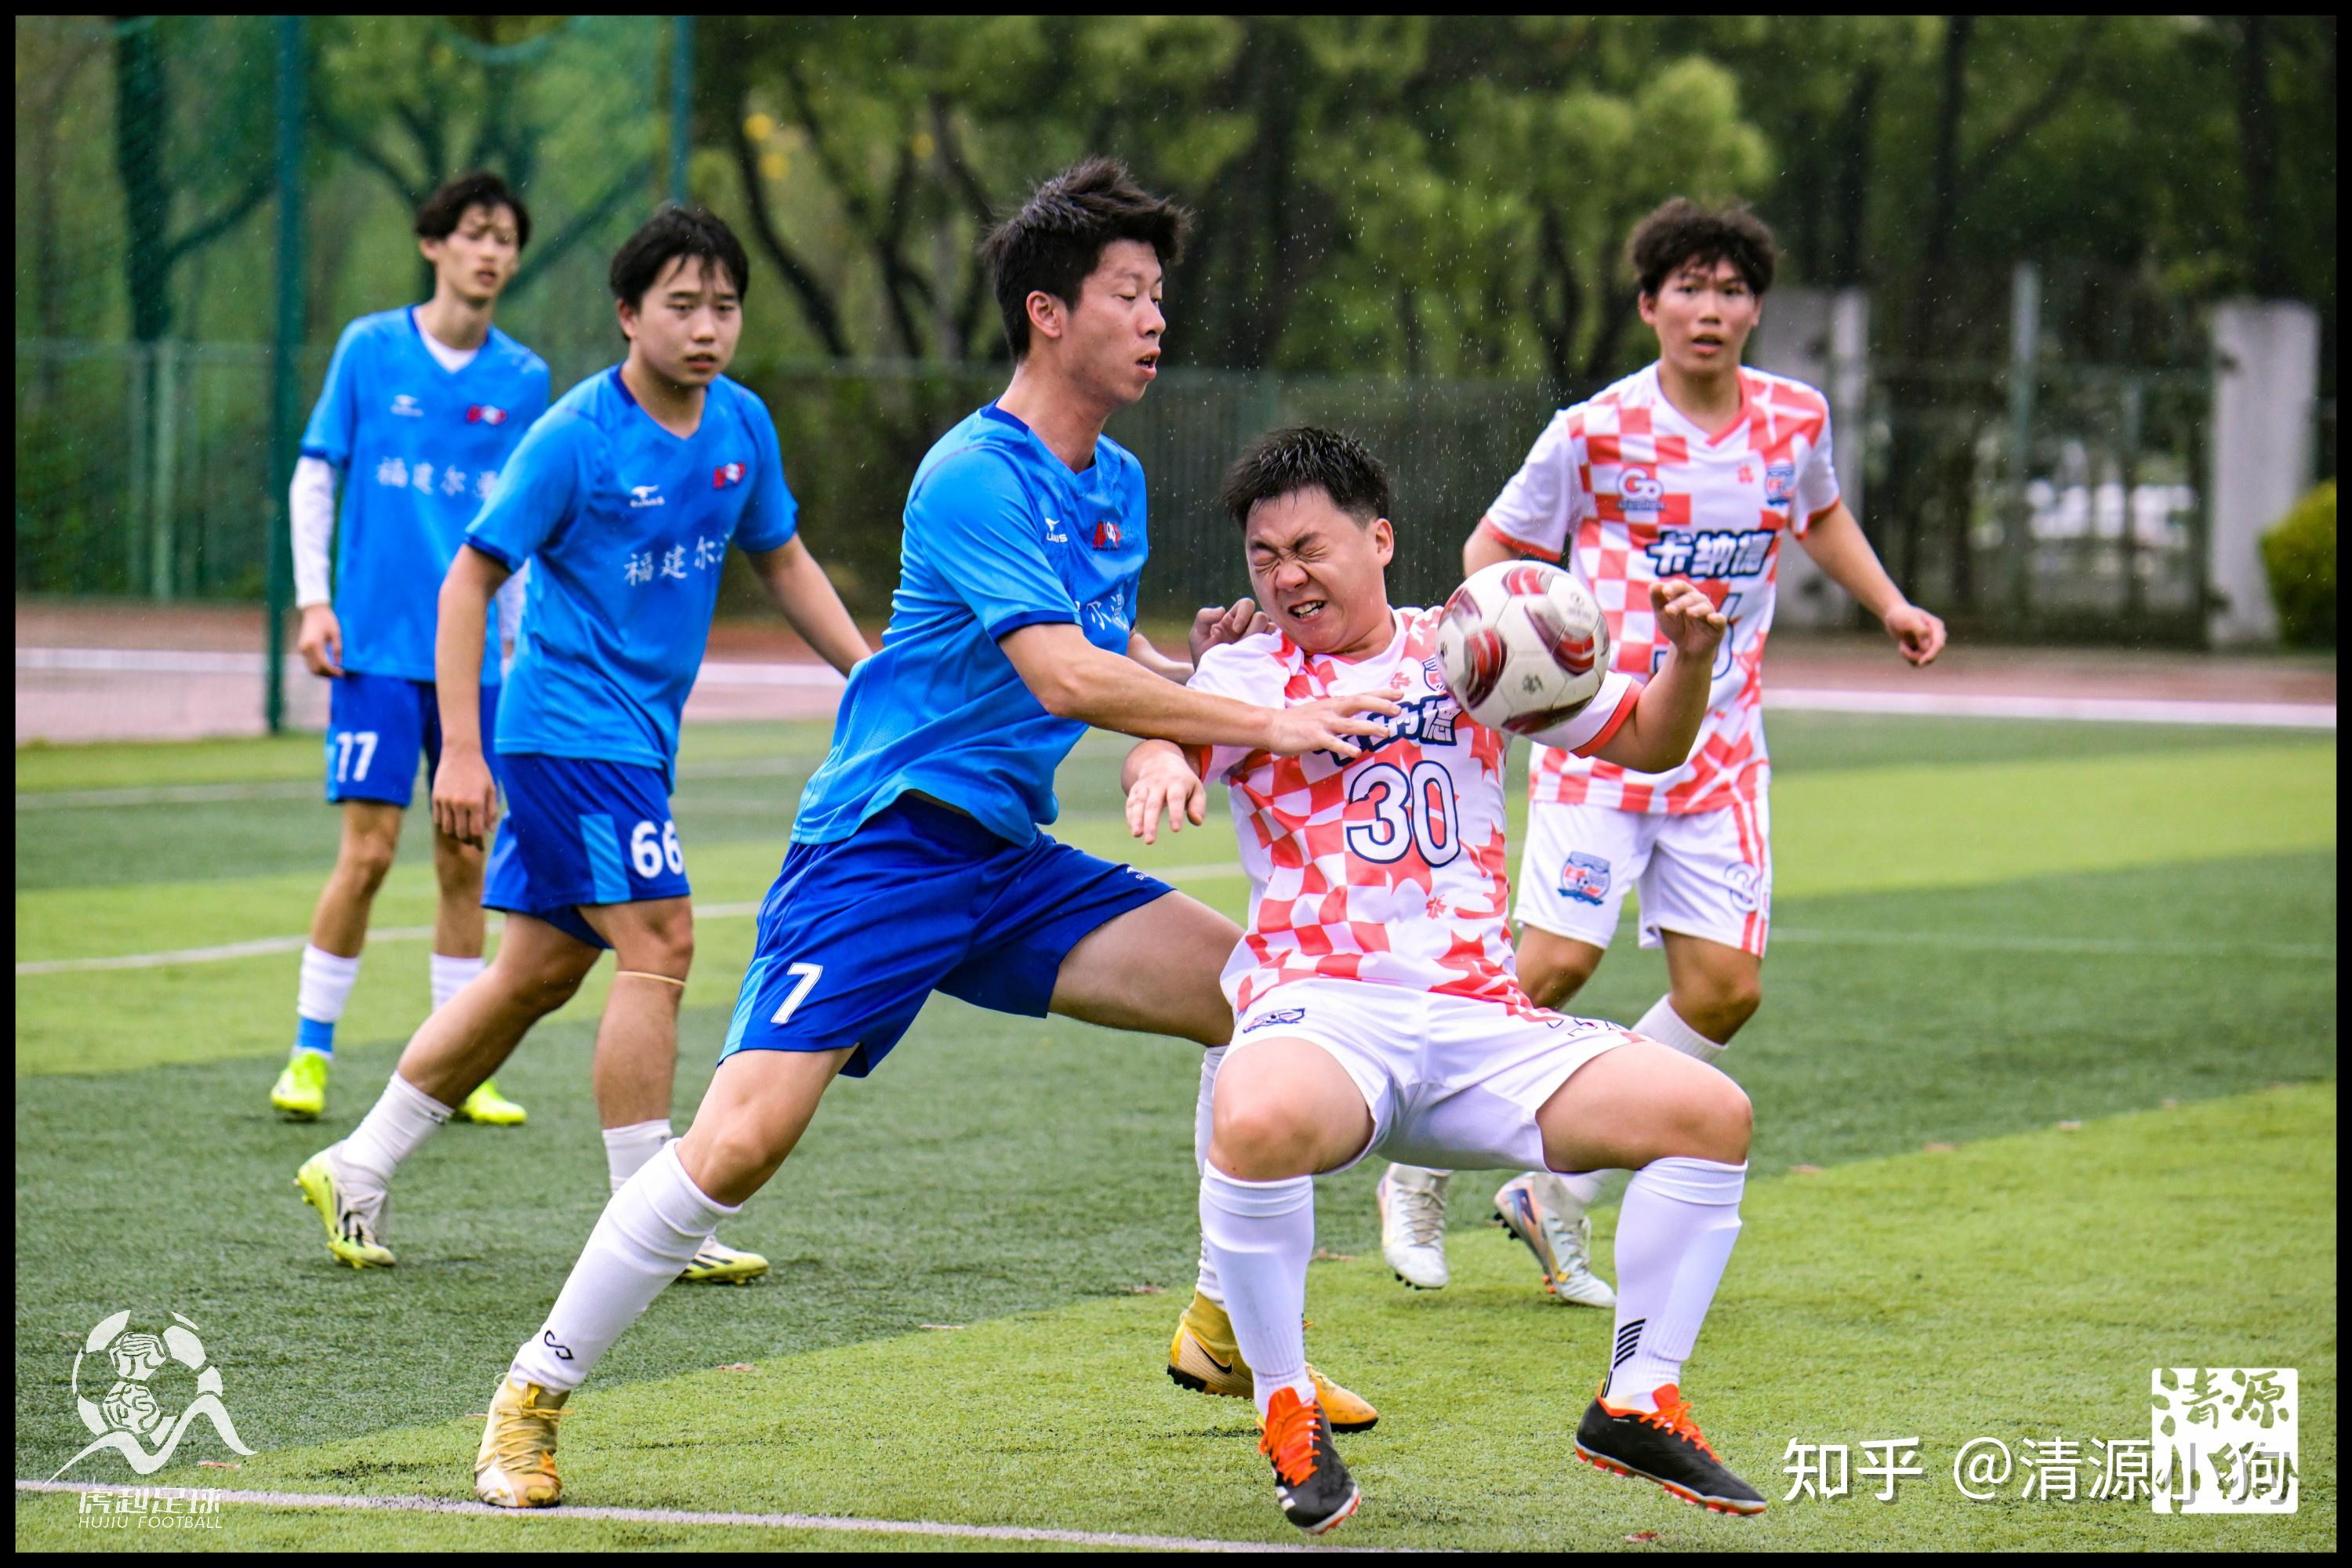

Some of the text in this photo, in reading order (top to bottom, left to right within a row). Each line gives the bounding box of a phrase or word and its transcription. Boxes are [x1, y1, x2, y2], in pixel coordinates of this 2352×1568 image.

[336, 731, 379, 782] 17
[1346, 760, 1461, 868] 30
[630, 819, 684, 878] 66
[770, 962, 823, 1024] 7
